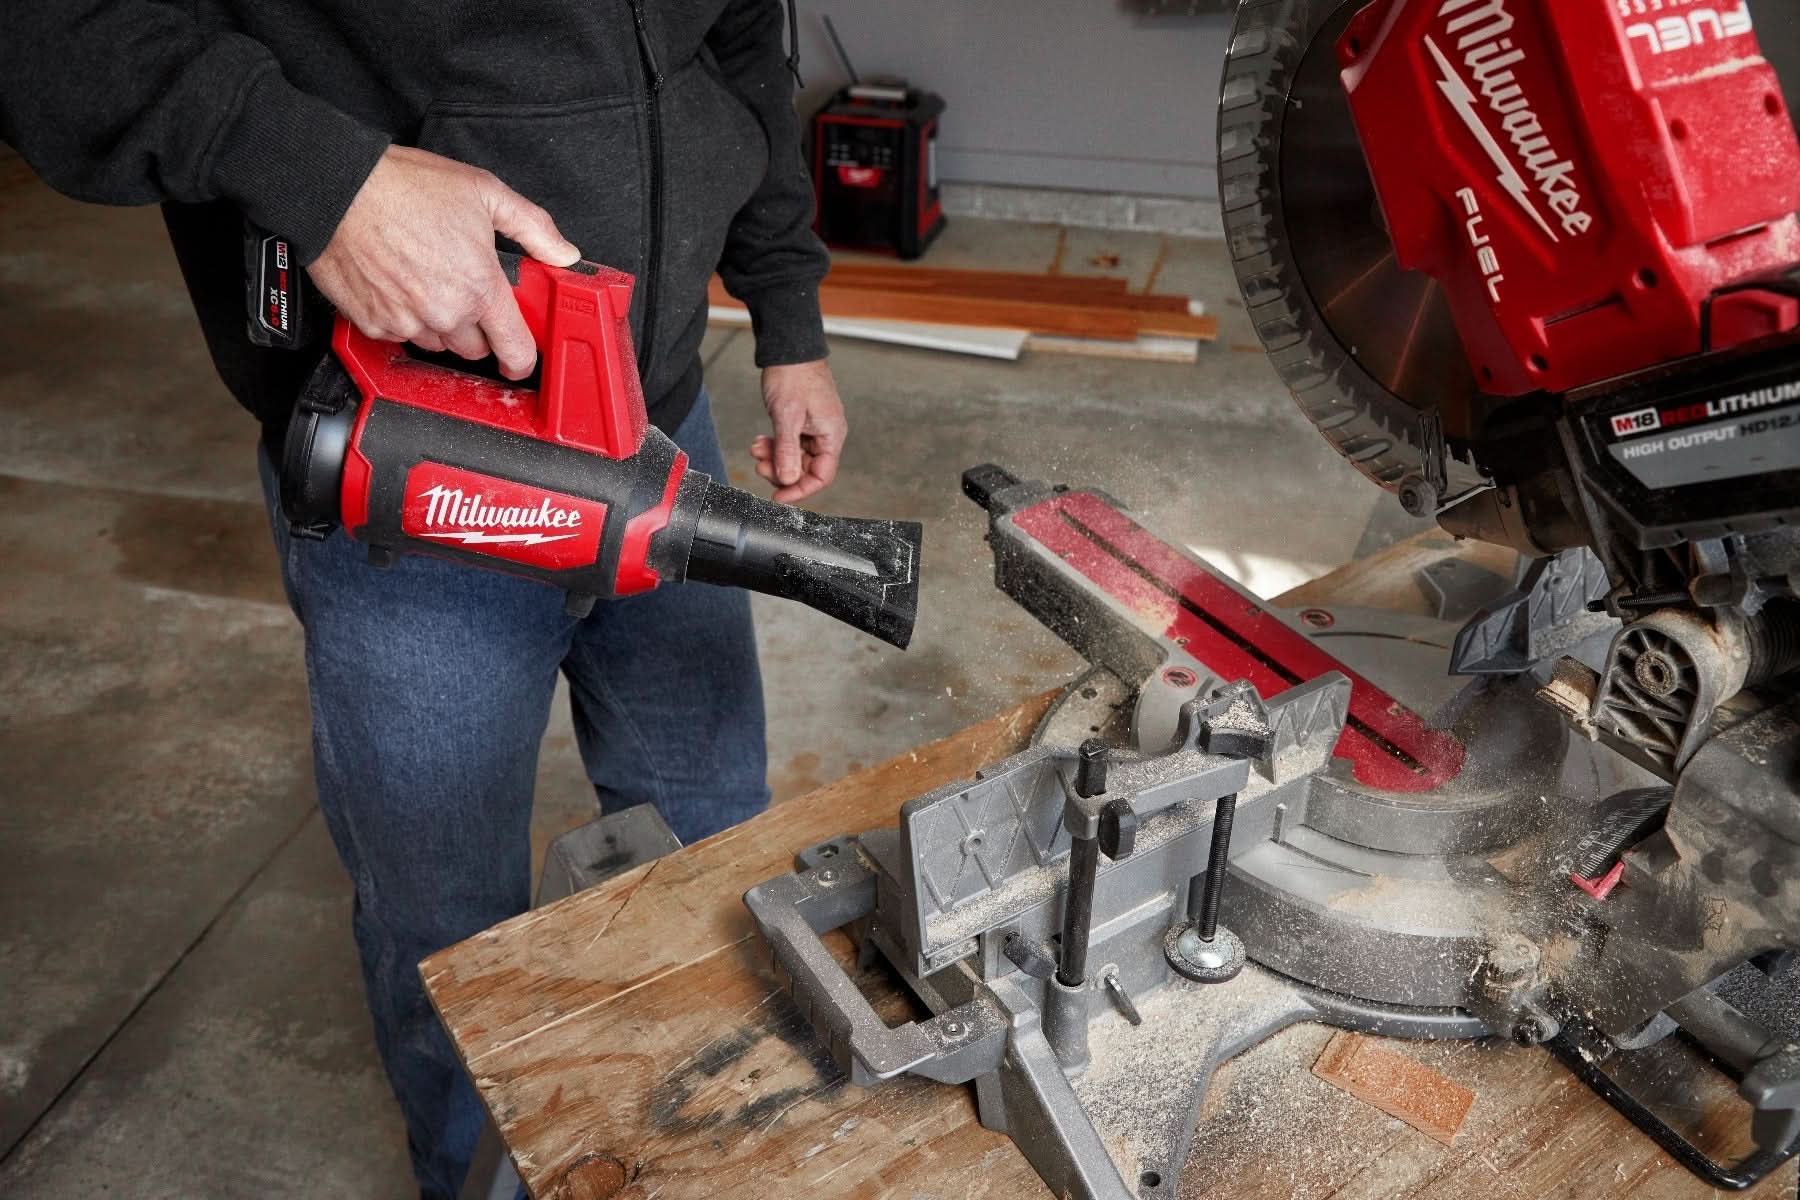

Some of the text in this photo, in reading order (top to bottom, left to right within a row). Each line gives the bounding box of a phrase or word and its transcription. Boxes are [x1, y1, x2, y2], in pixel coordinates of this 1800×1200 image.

[1625, 0, 1752, 54] FUEL
[1436, 0, 1592, 237] Milwaukee
[277, 243, 287, 268] M12
[1455, 186, 1504, 303] FUEL
[1614, 381, 1800, 433] M18 REDLITHIUM
[1623, 412, 1800, 460] HIGH OUTPUT HD12.
[416, 484, 582, 529] Milwaukee
